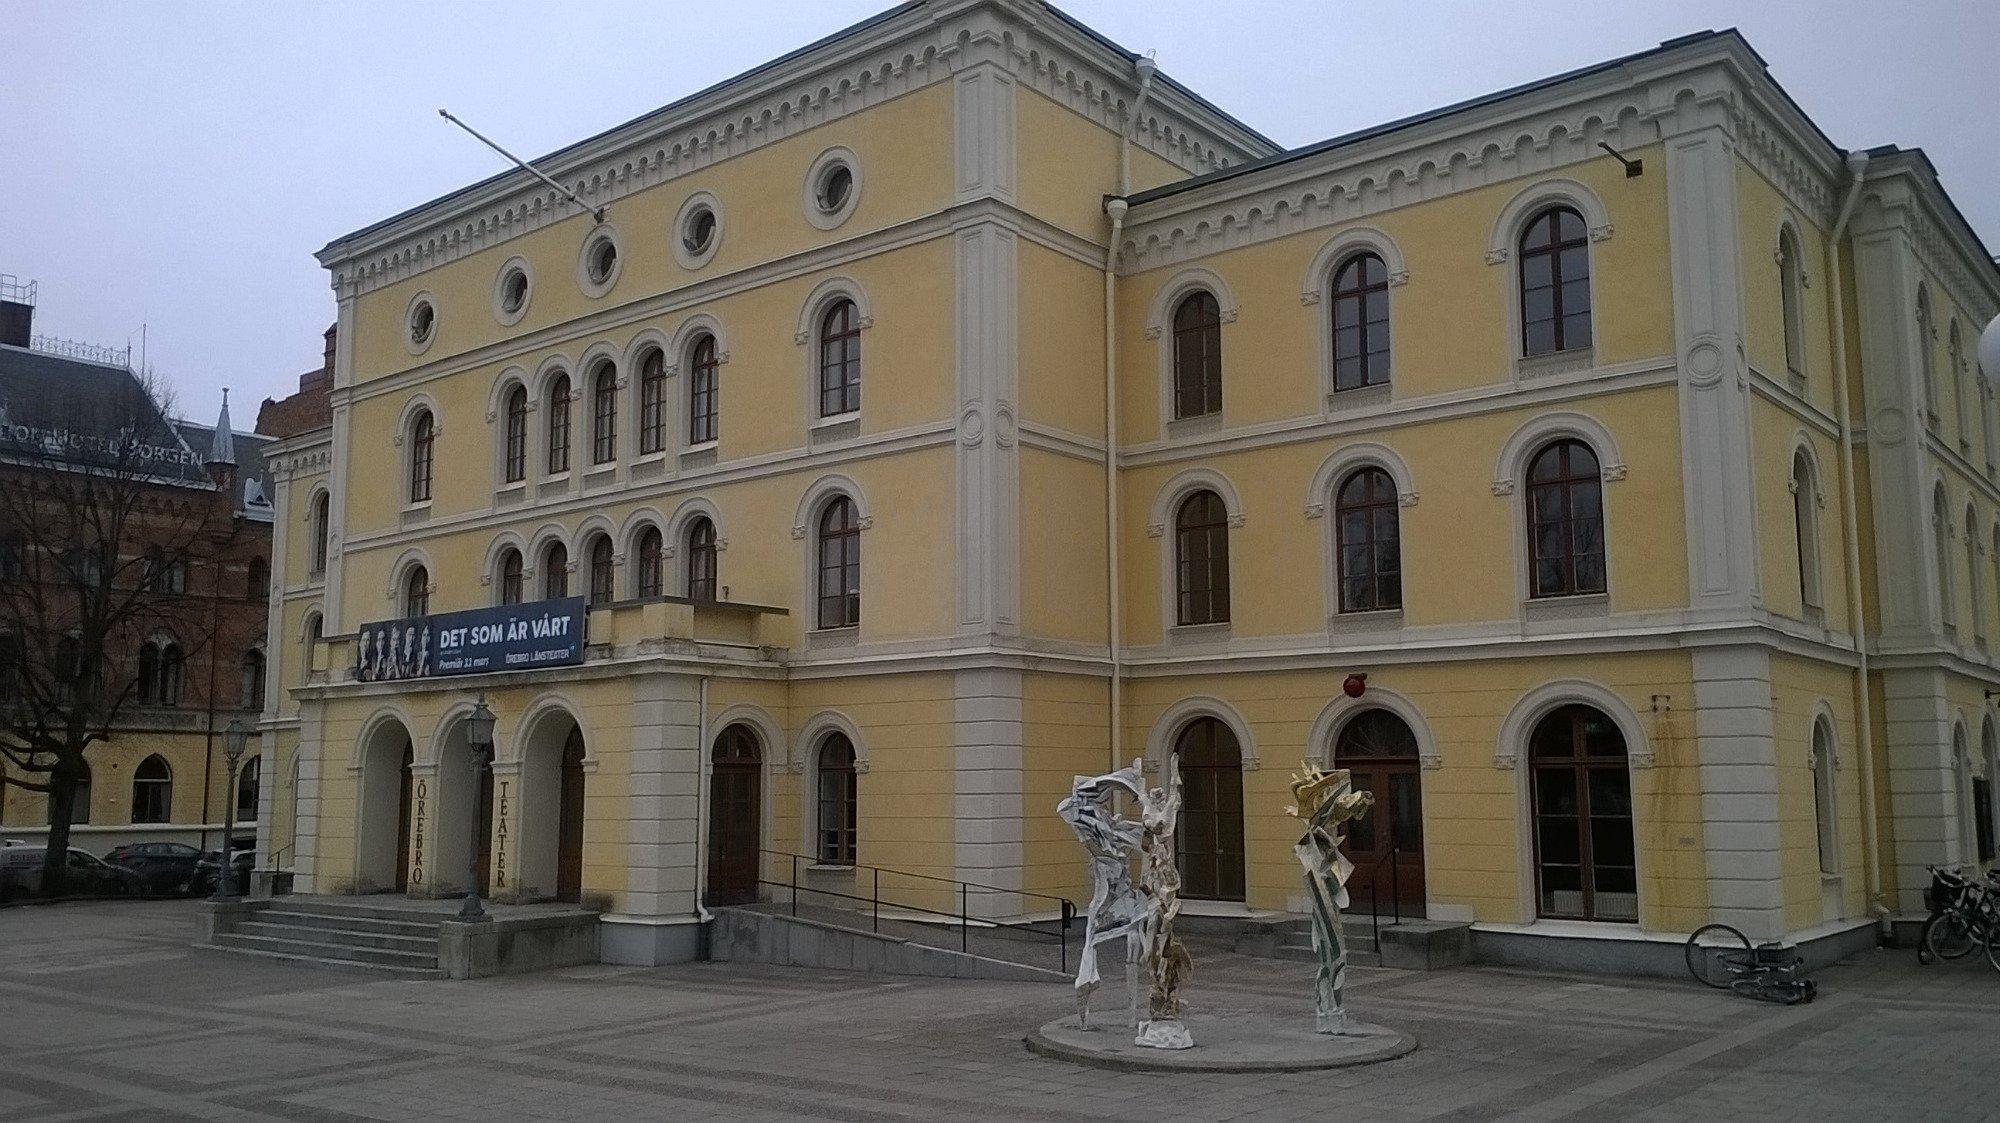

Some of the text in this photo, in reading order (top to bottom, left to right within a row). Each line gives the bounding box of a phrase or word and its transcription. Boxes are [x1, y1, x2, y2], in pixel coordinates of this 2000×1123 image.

[440, 612, 571, 648] DET SOM ÄR VÅRT
[505, 652, 529, 664] ÖREBRO
[413, 779, 427, 884] ÖREBRO
[497, 781, 509, 888] TEATER
